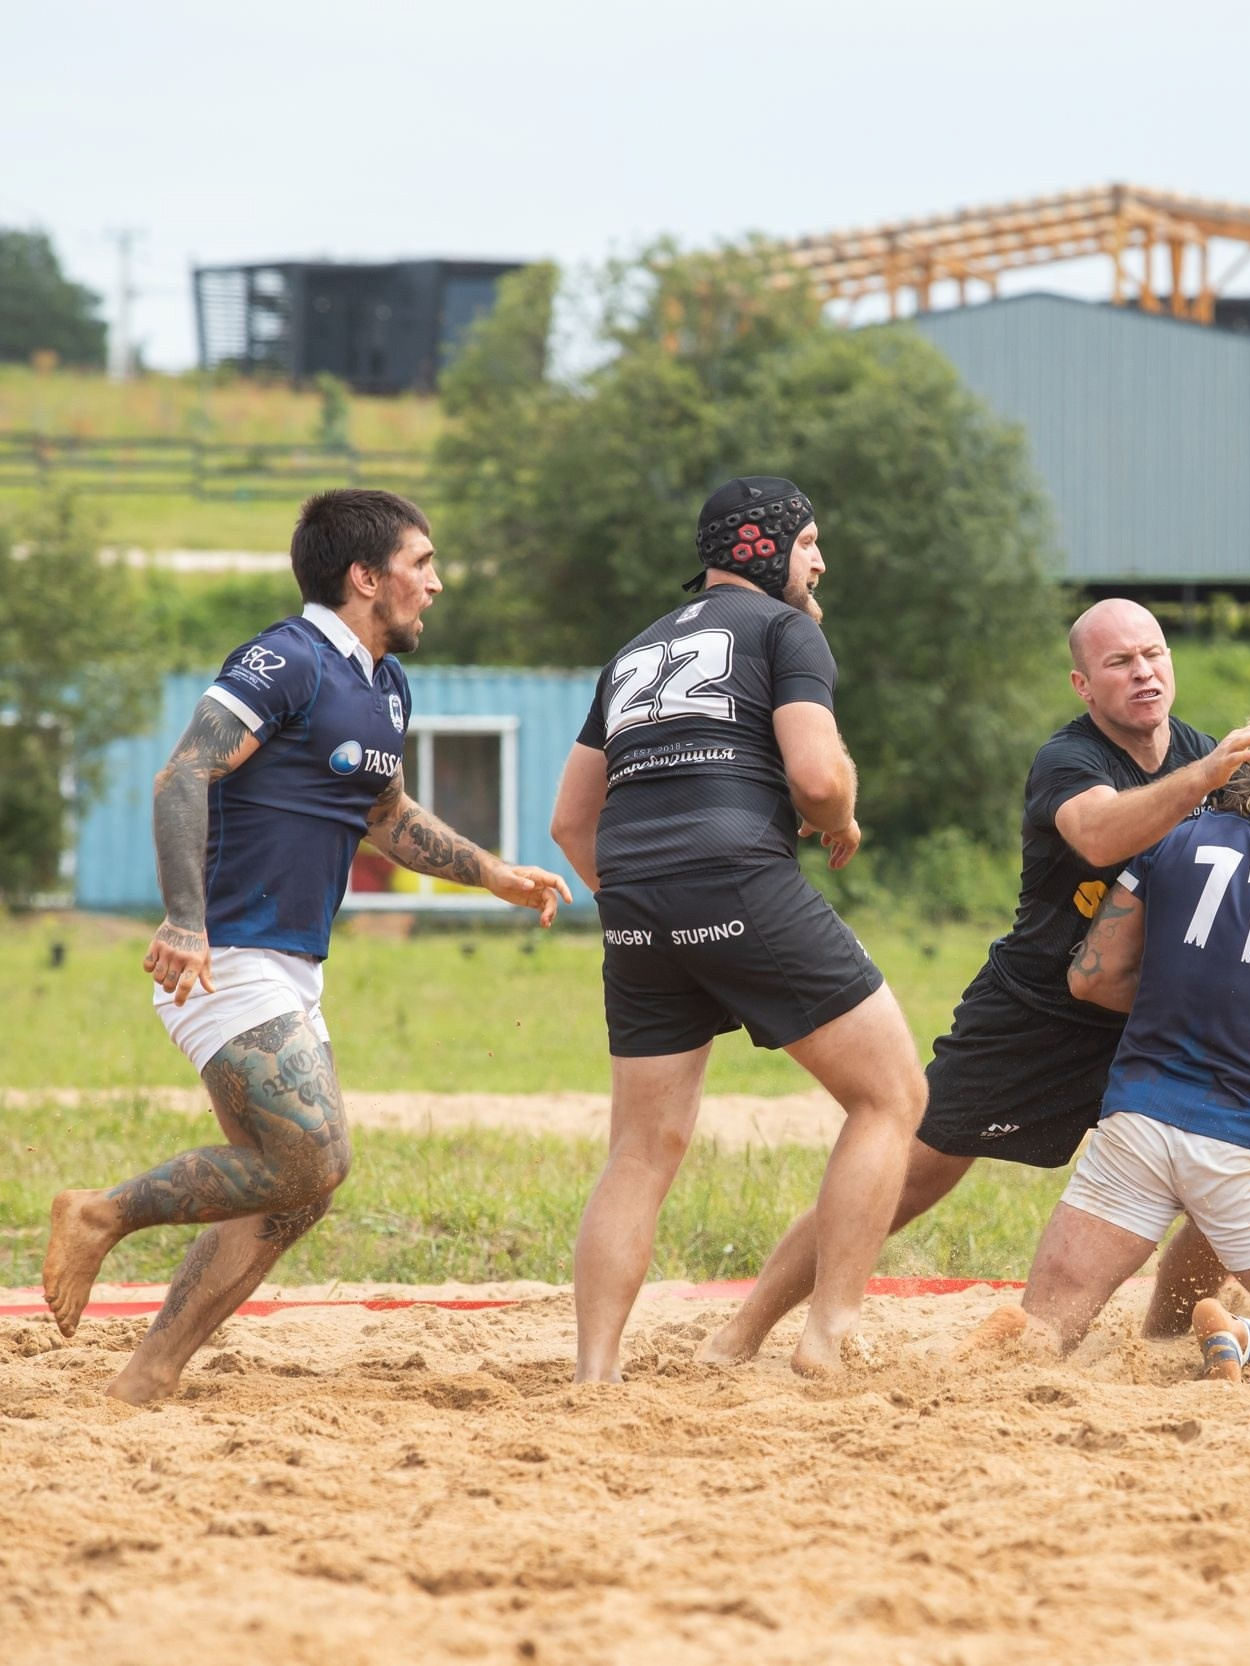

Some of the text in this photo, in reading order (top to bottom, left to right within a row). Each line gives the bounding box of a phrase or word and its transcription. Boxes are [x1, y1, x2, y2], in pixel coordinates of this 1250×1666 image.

[605, 629, 736, 749] 22
[658, 743, 681, 754] 2018
[671, 920, 745, 945] STUPINO
